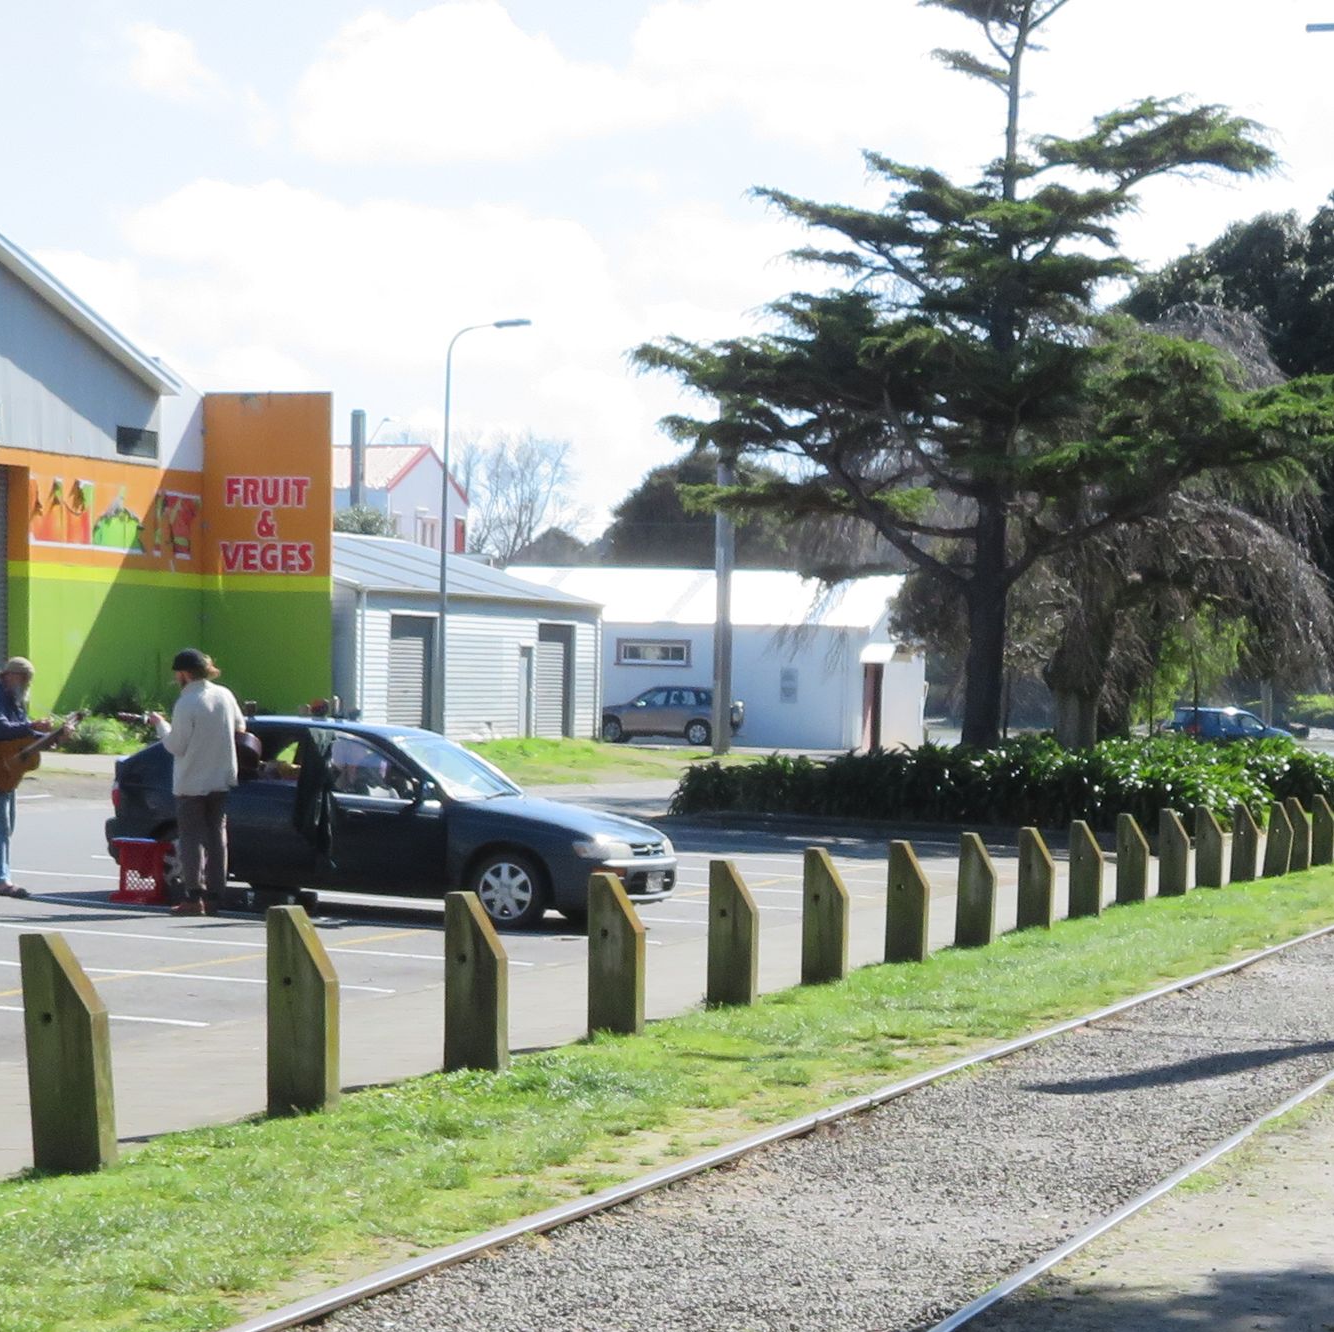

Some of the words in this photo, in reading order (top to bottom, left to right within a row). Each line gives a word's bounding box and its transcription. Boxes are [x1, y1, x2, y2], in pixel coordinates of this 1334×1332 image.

[225, 476, 310, 507] FRUIT
[257, 509, 276, 538] &
[220, 541, 314, 573] VEGES
